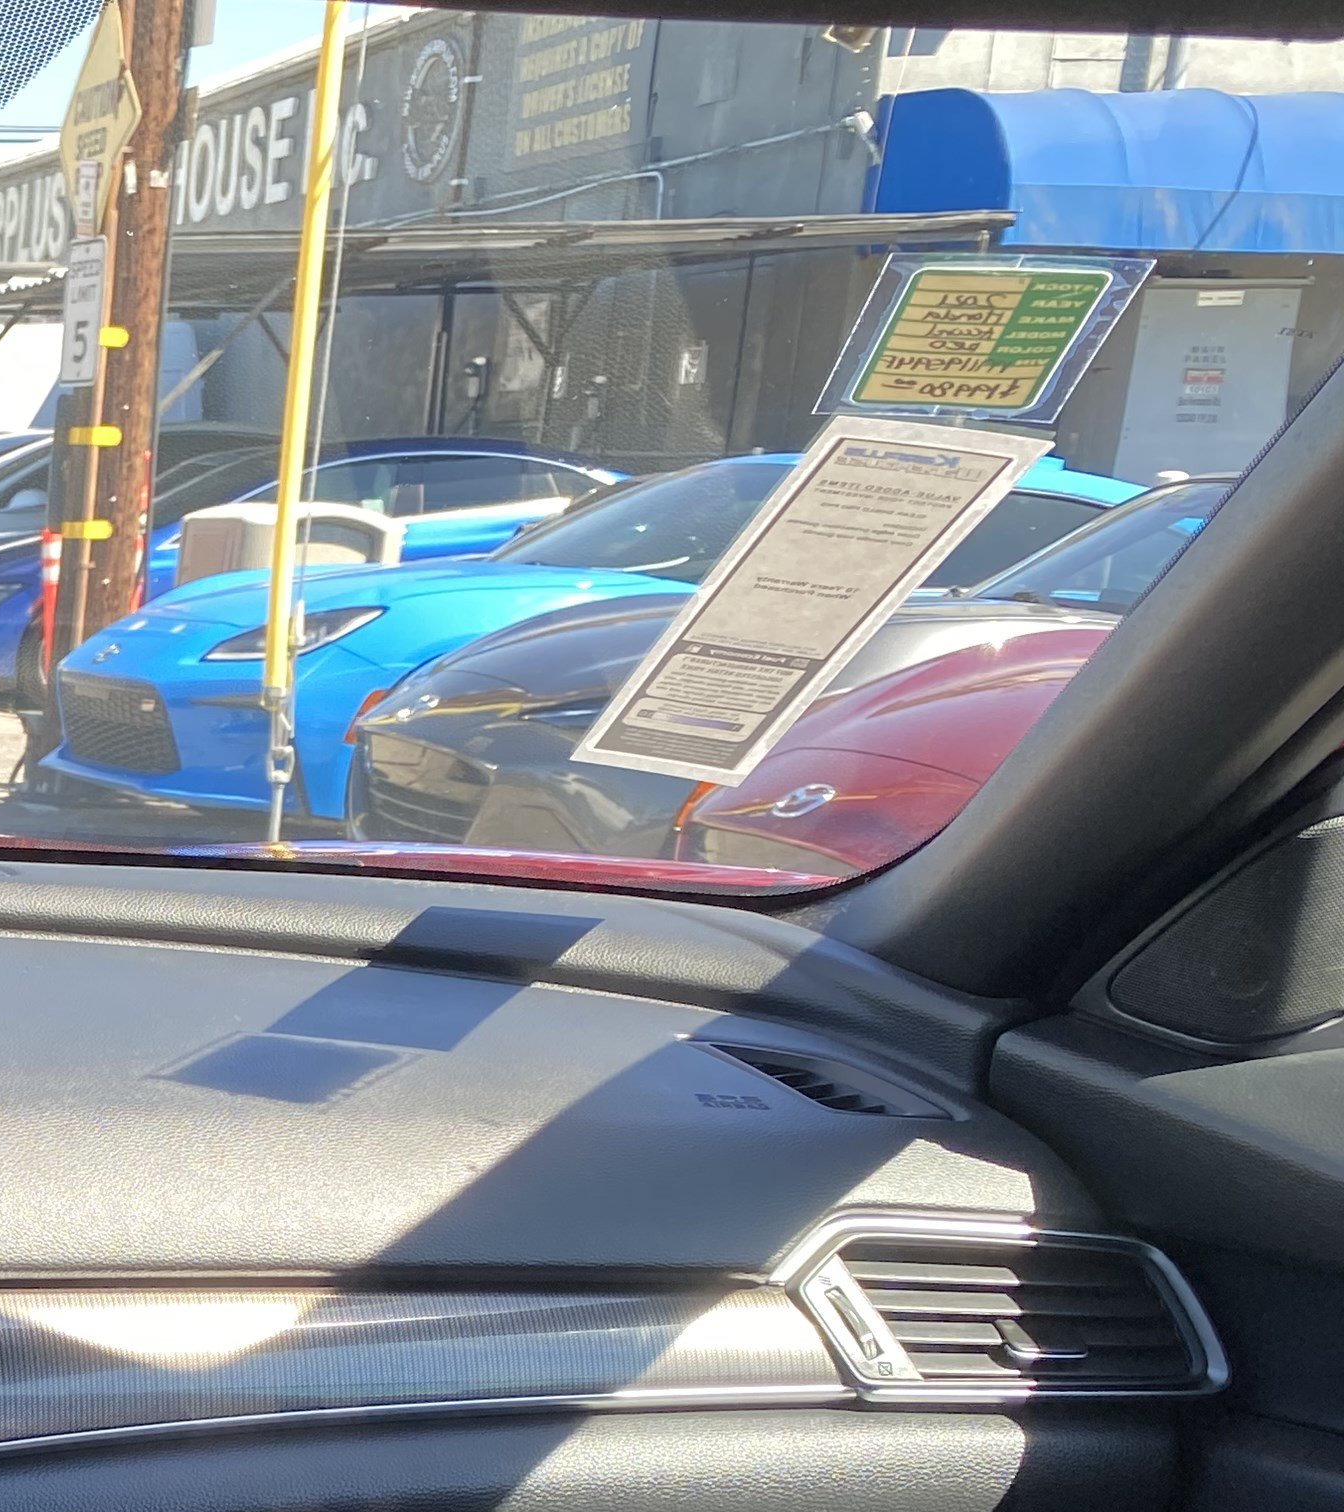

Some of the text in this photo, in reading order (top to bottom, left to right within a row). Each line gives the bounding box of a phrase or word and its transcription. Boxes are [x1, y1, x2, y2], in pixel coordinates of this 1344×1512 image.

[590, 25, 627, 61] COPY
[627, 19, 645, 50] OF
[576, 63, 631, 102] LICENSE
[555, 103, 631, 147] CUSTOMERS
[72, 321, 89, 363] 5
